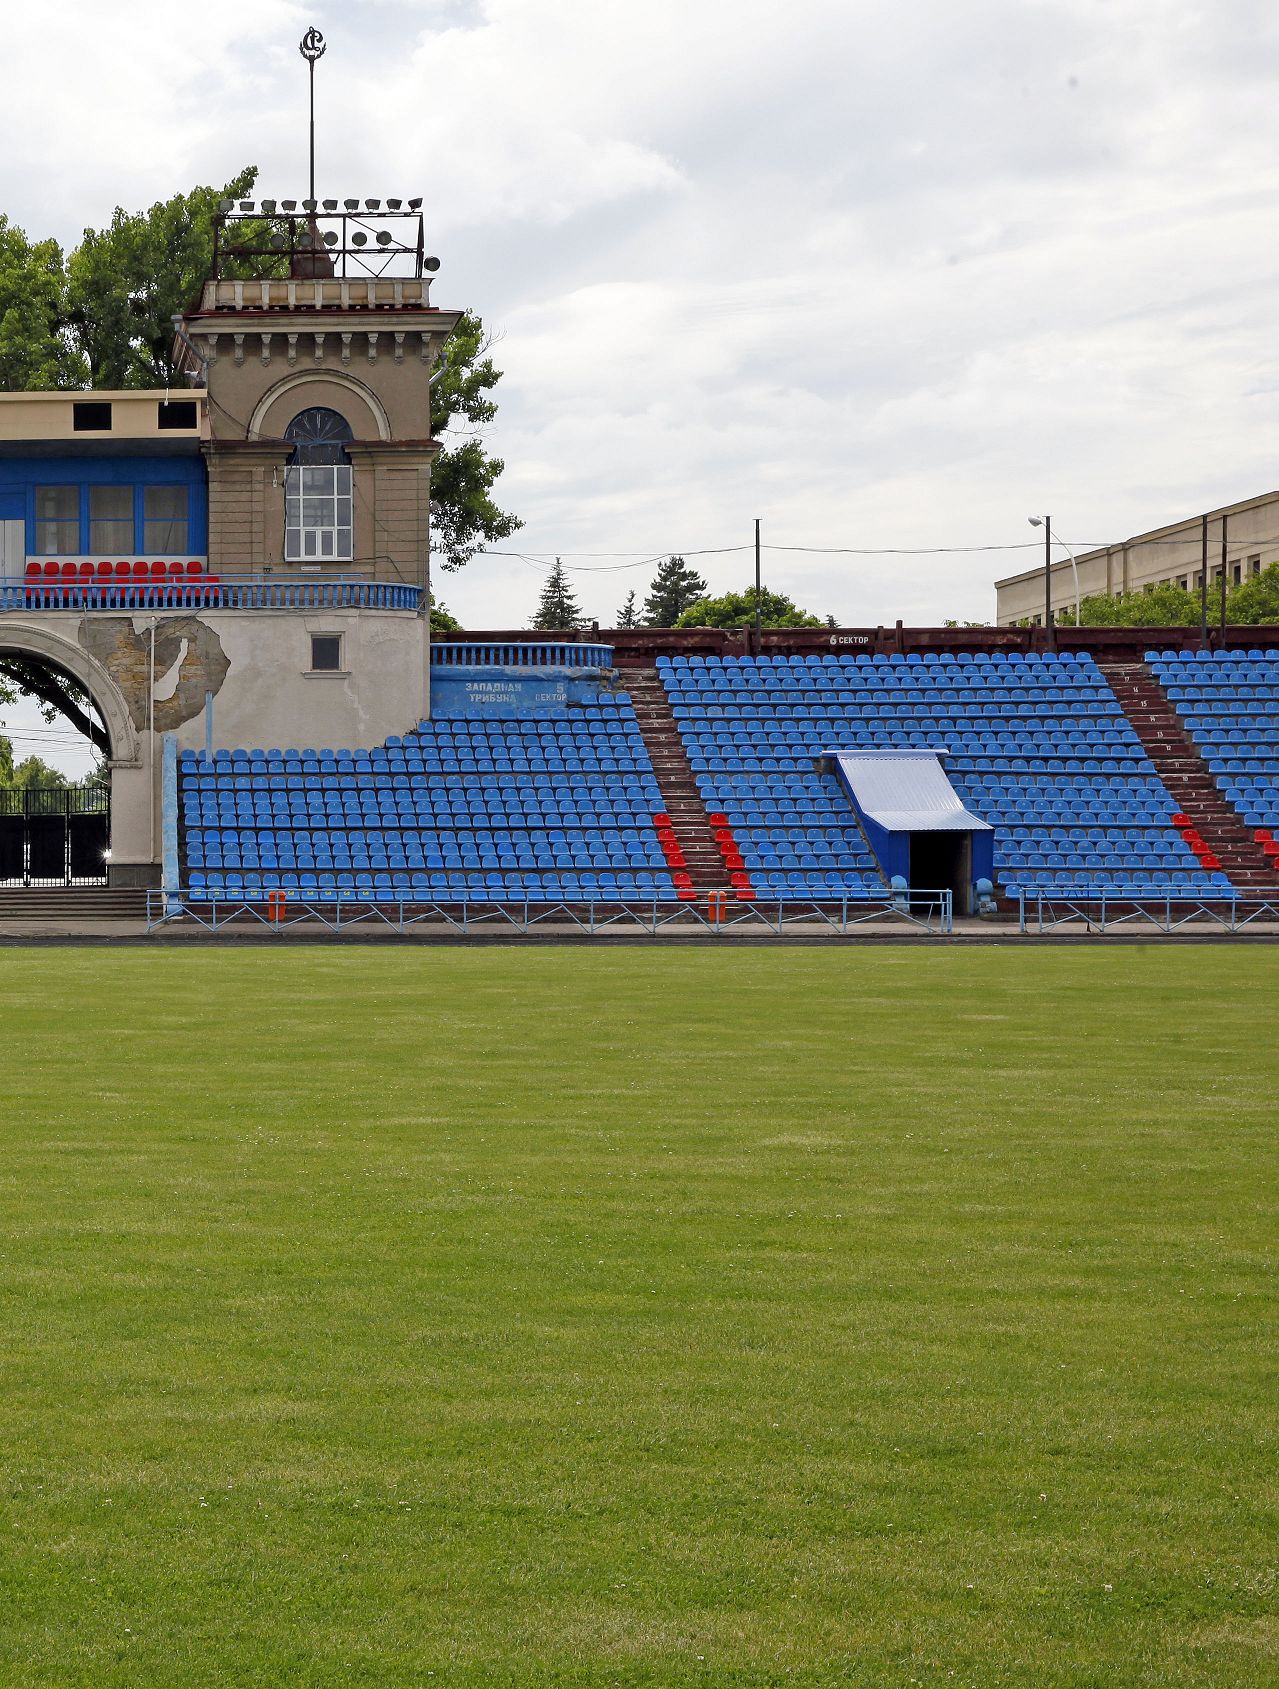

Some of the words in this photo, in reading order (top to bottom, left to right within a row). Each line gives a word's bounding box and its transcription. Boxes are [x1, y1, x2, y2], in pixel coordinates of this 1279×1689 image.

[830, 635, 836, 645] 6
[838, 636, 869, 644] СЕКТОР
[465, 682, 522, 692] ЗАПАДНАЯ
[556, 683, 564, 694] 5
